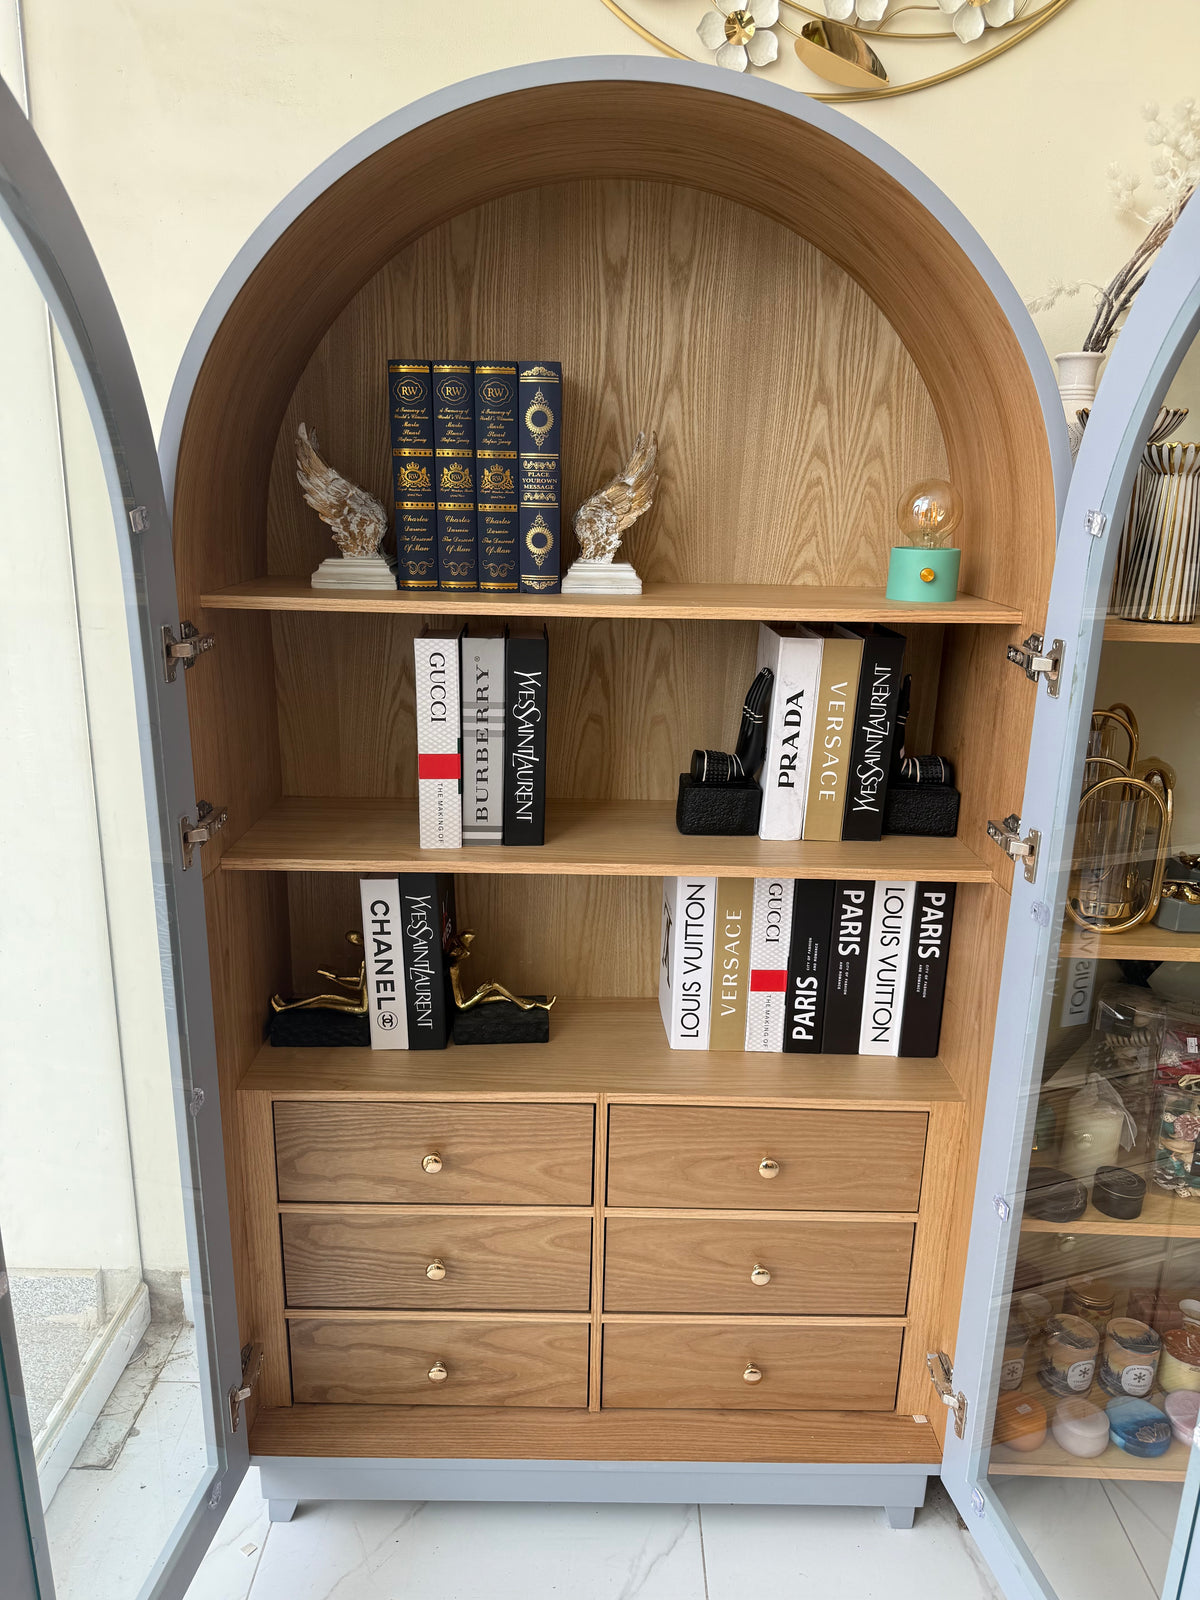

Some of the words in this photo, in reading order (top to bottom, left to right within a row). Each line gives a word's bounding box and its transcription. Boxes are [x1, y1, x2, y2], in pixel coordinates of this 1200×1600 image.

[402, 386, 419, 397] RW
[446, 386, 463, 397] RW
[487, 387, 505, 398] RW
[445, 515, 470, 523] Charles
[485, 516, 511, 524] Charles
[429, 652, 446, 722] GUCCI
[778, 689, 805, 788] PRADA
[818, 682, 848, 802] VERSACE
[438, 833, 444, 844] OF
[683, 884, 706, 974] VUITTON
[765, 883, 783, 942] GUCCI
[838, 890, 866, 956] PARIS
[880, 887, 905, 947] LOUIS
[917, 892, 946, 959] PARIS
[370, 900, 396, 1010] CHANEL
[720, 909, 743, 1016] VERSACE
[680, 981, 702, 1038] LOUIS
[792, 976, 818, 1041] PARIS
[870, 953, 898, 1042] VUITTON
[763, 1038, 769, 1048] OF
